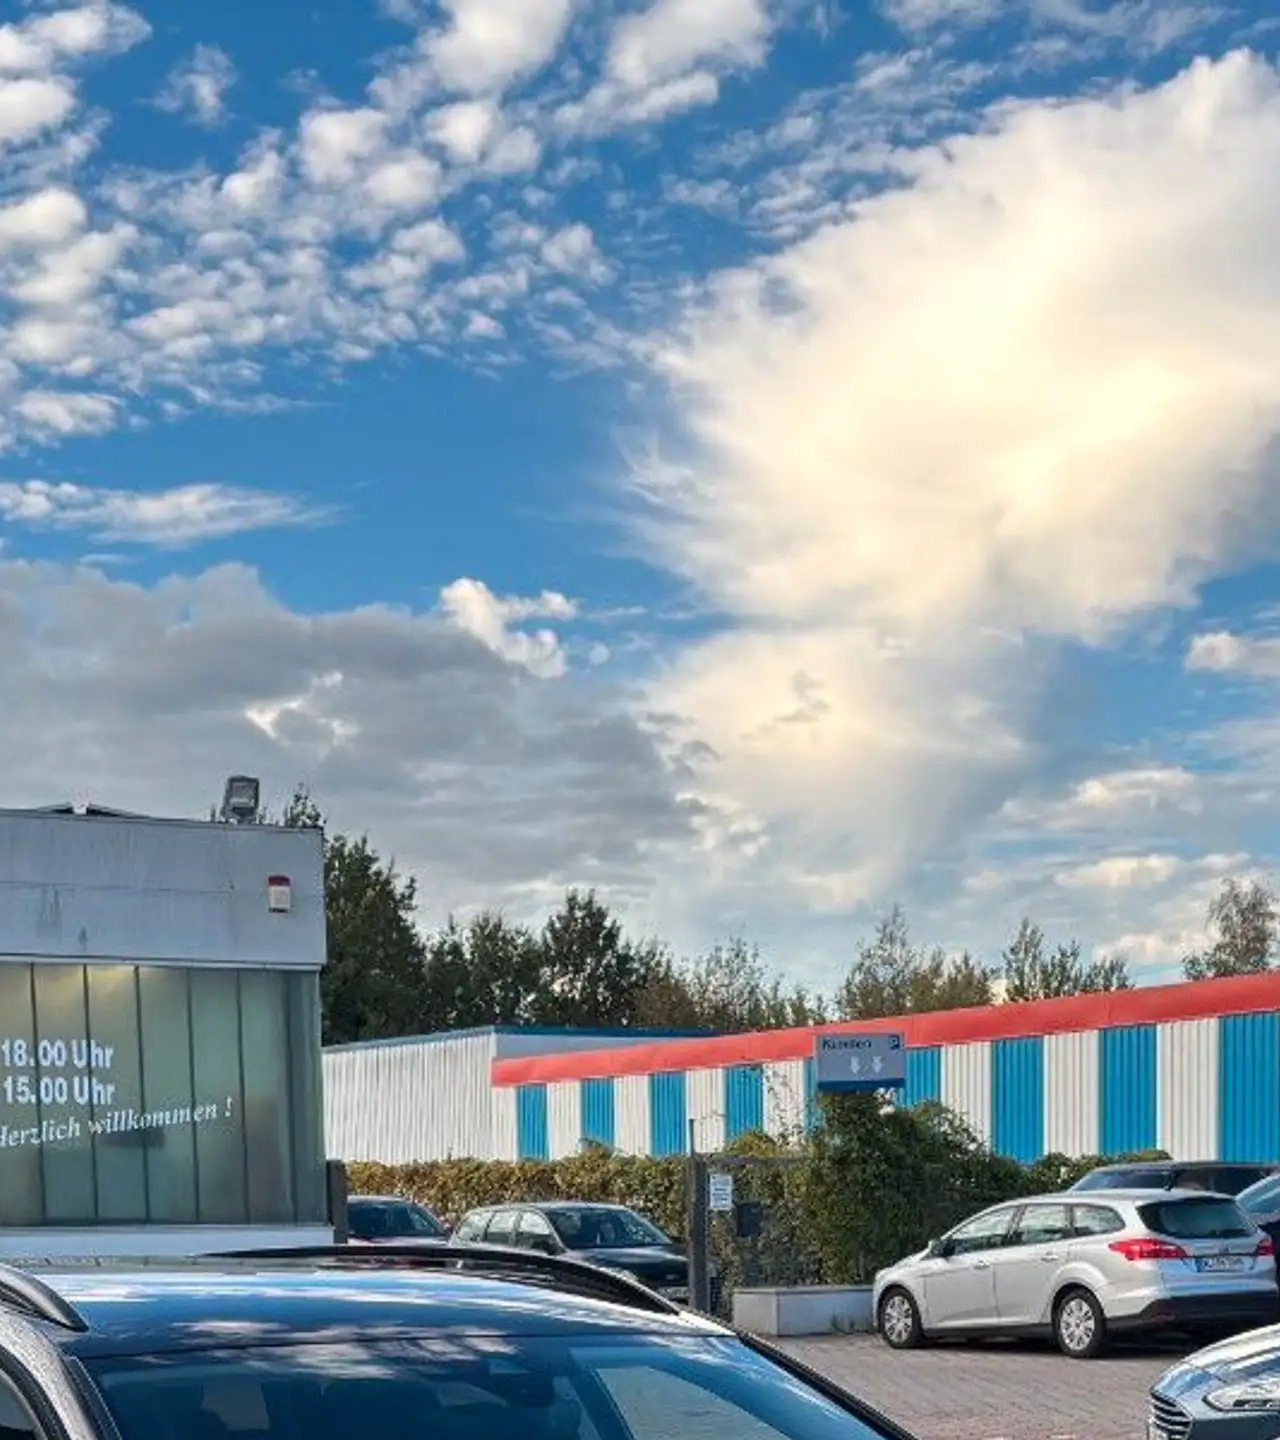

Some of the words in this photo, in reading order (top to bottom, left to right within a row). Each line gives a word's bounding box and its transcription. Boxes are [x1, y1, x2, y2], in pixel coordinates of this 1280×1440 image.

[2, 1039, 67, 1068] 18.00
[72, 1039, 114, 1069] Uhr
[3, 1075, 68, 1104] 15.00
[73, 1076, 115, 1106] Uhr
[88, 1103, 218, 1135] willkommen
